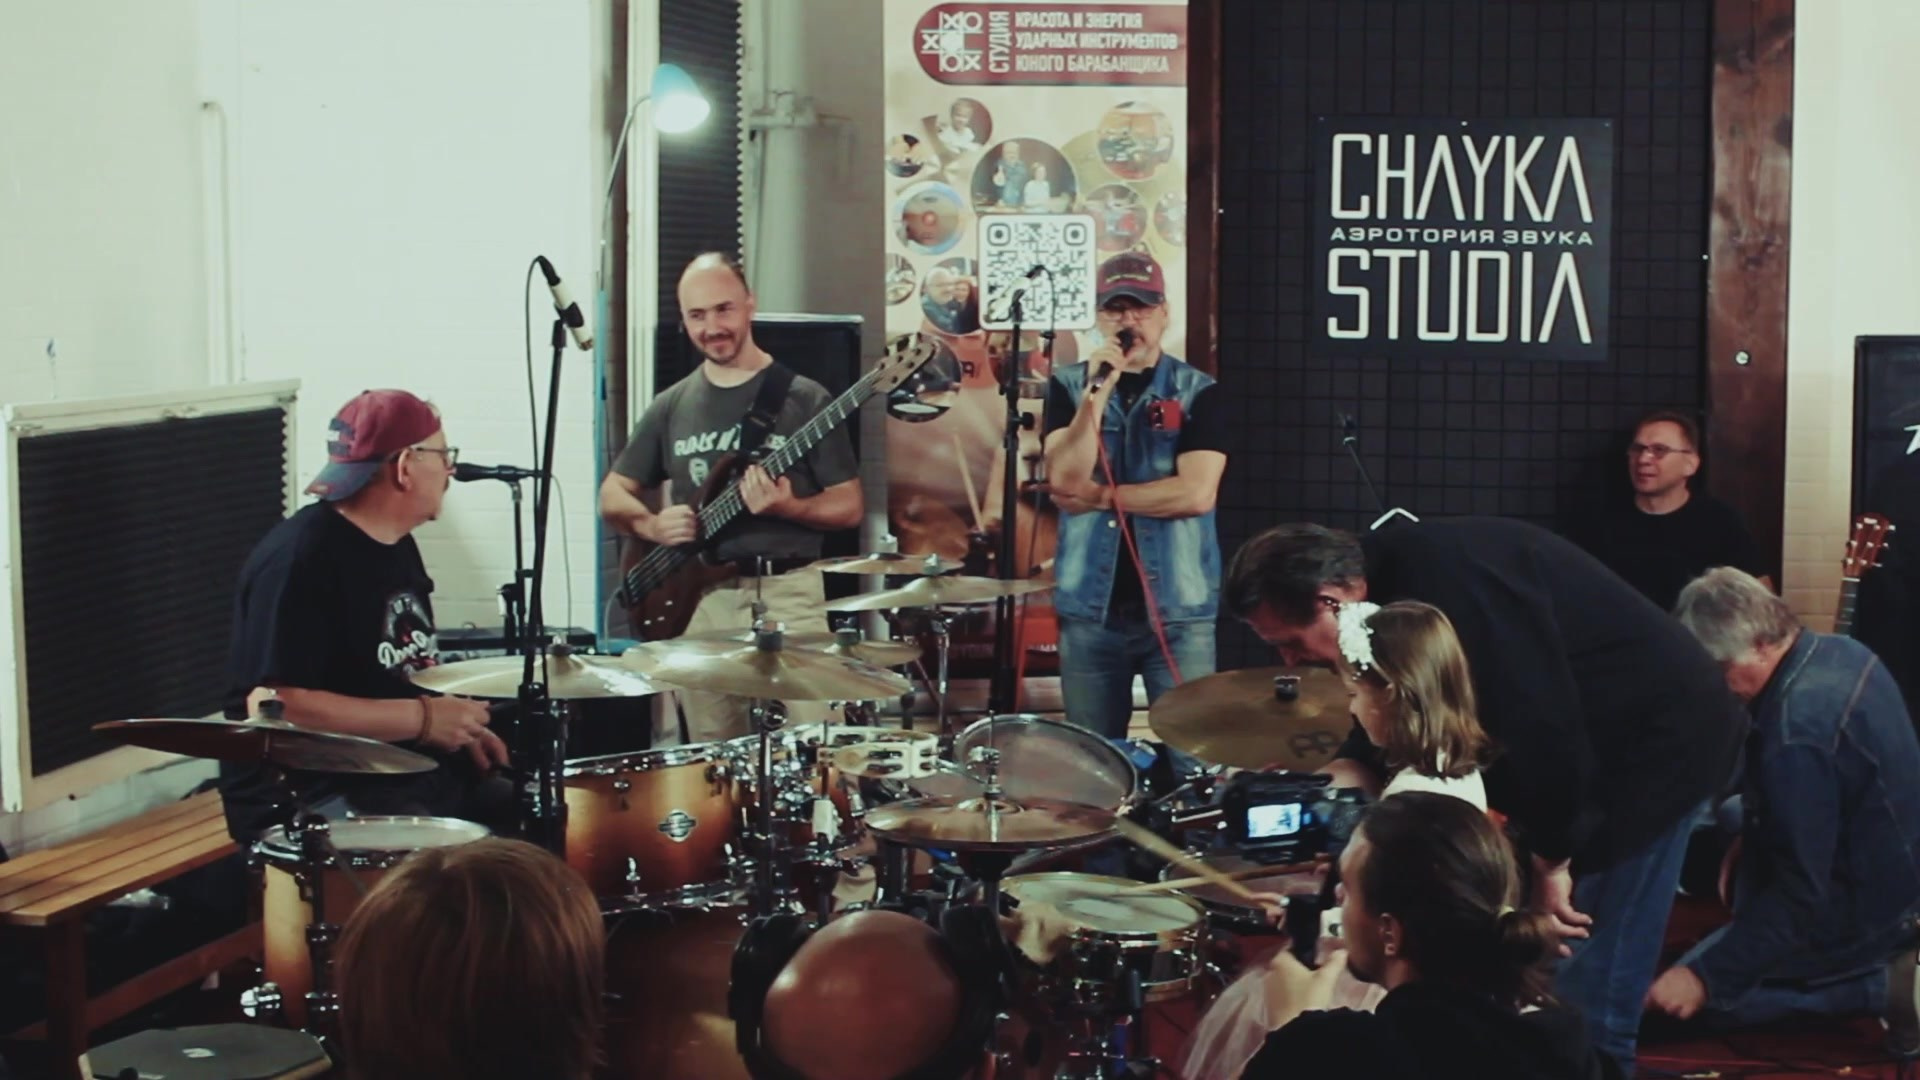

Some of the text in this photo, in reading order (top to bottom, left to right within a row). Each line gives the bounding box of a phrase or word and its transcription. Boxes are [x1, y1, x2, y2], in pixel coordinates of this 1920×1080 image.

[1015, 11, 1143, 29] КРАСОТА И ЭНЕРГИЯ
[988, 11, 1010, 73] СТУДИЯ
[1015, 32, 1178, 50] УДАРНЫХ ИНСТРУМЕНТОВ
[1015, 54, 1169, 74] ЮНОГО БАРАБАНЩИКА
[1331, 133, 1593, 223] CHAYKA
[1330, 227, 1593, 246] АЭРОТОРИЯ ЗВУКА
[1327, 248, 1592, 344] STUDIA
